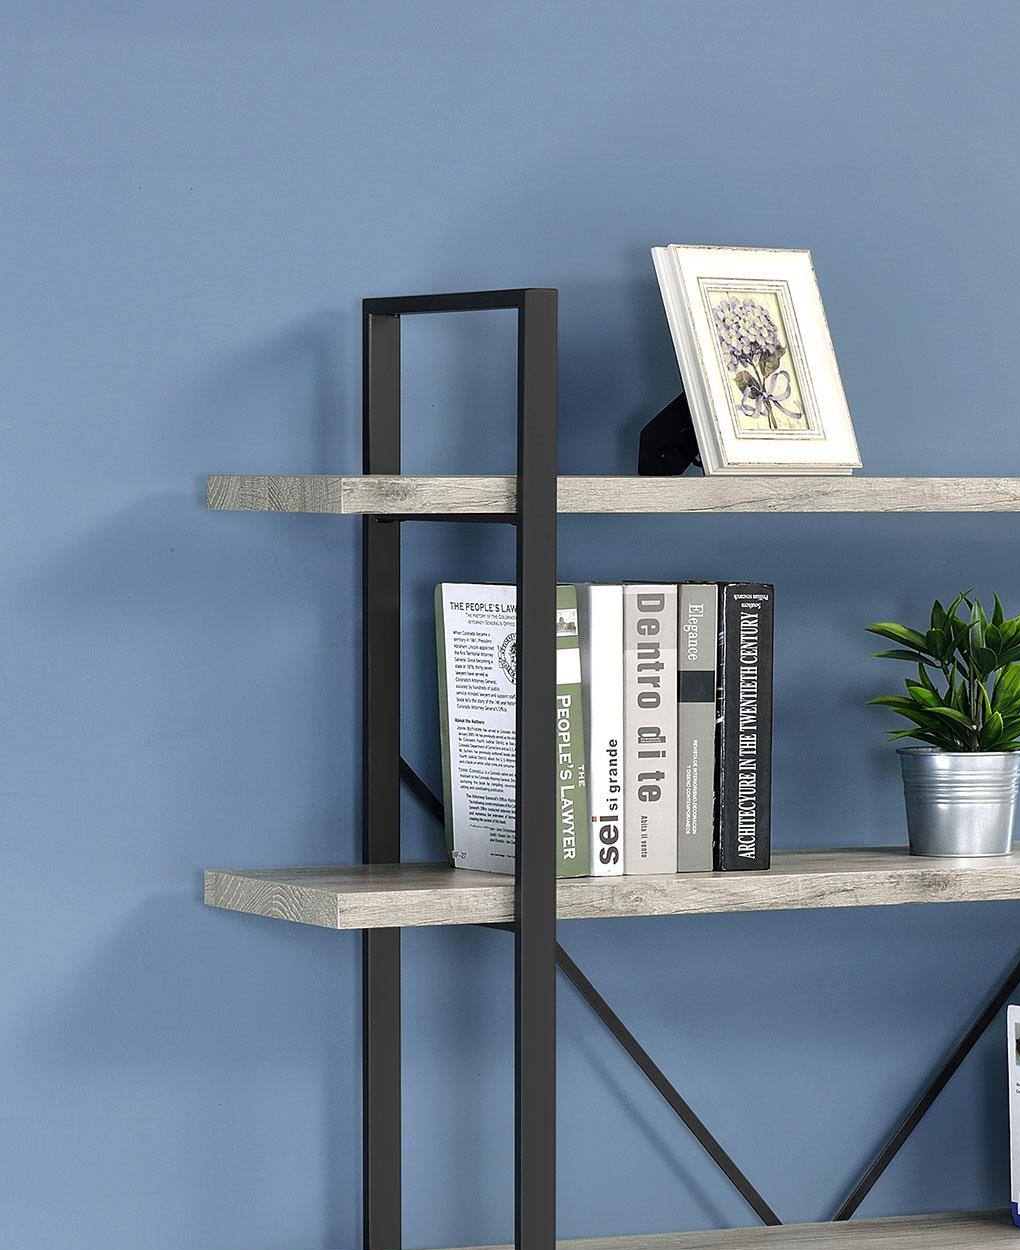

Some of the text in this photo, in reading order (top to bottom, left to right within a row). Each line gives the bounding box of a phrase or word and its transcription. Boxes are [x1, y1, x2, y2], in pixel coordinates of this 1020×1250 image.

[450, 601, 464, 611] THE
[465, 602, 500, 613] PEOPLE'S
[683, 603, 704, 661] Elegance
[637, 593, 665, 709] Dentro
[739, 611, 759, 664] CENTURY
[739, 666, 758, 732] TWENTIETH
[606, 739, 621, 793] grande
[738, 758, 757, 771] IN
[739, 733, 757, 757] THE
[556, 694, 576, 860] PEOPLE'S LAWYER
[578, 764, 586, 787] THE
[606, 798, 618, 811] si
